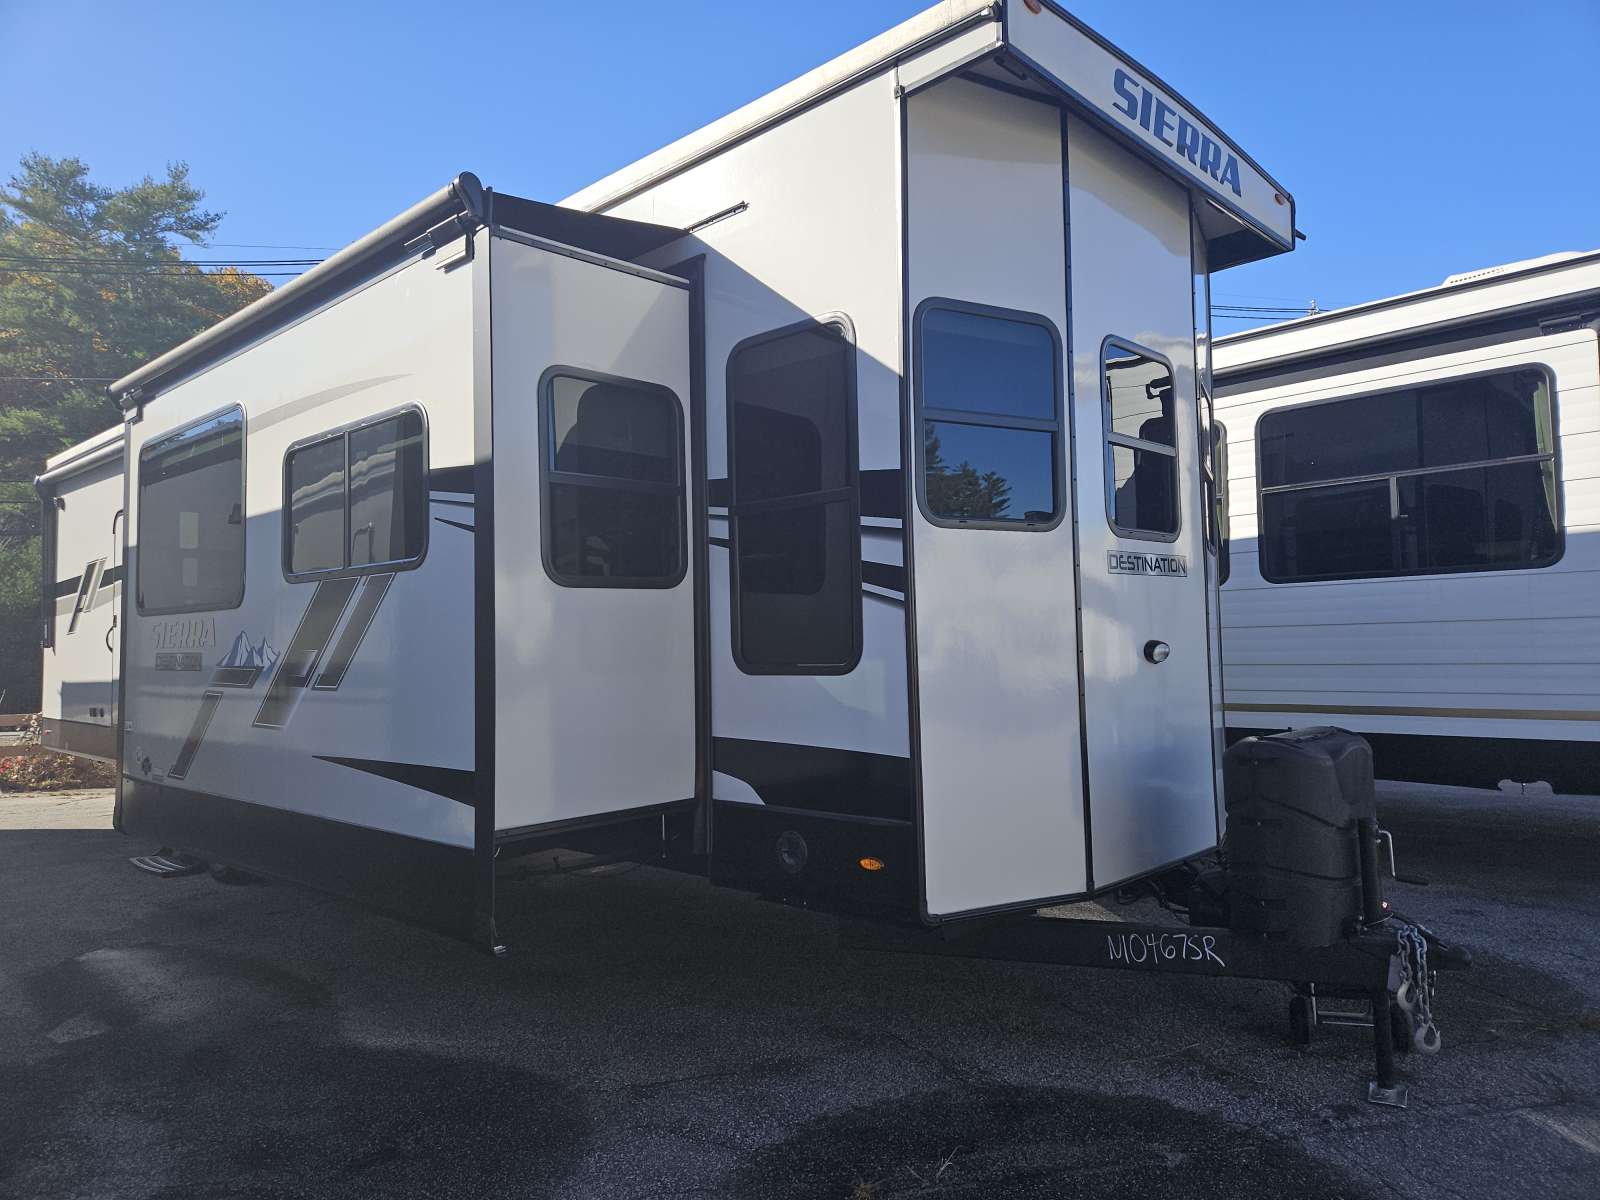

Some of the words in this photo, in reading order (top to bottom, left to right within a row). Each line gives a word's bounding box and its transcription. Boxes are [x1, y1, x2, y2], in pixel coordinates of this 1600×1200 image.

[1112, 68, 1242, 197] SIERRA
[1108, 553, 1186, 574] DESTINATION
[152, 617, 215, 649] SIERRA
